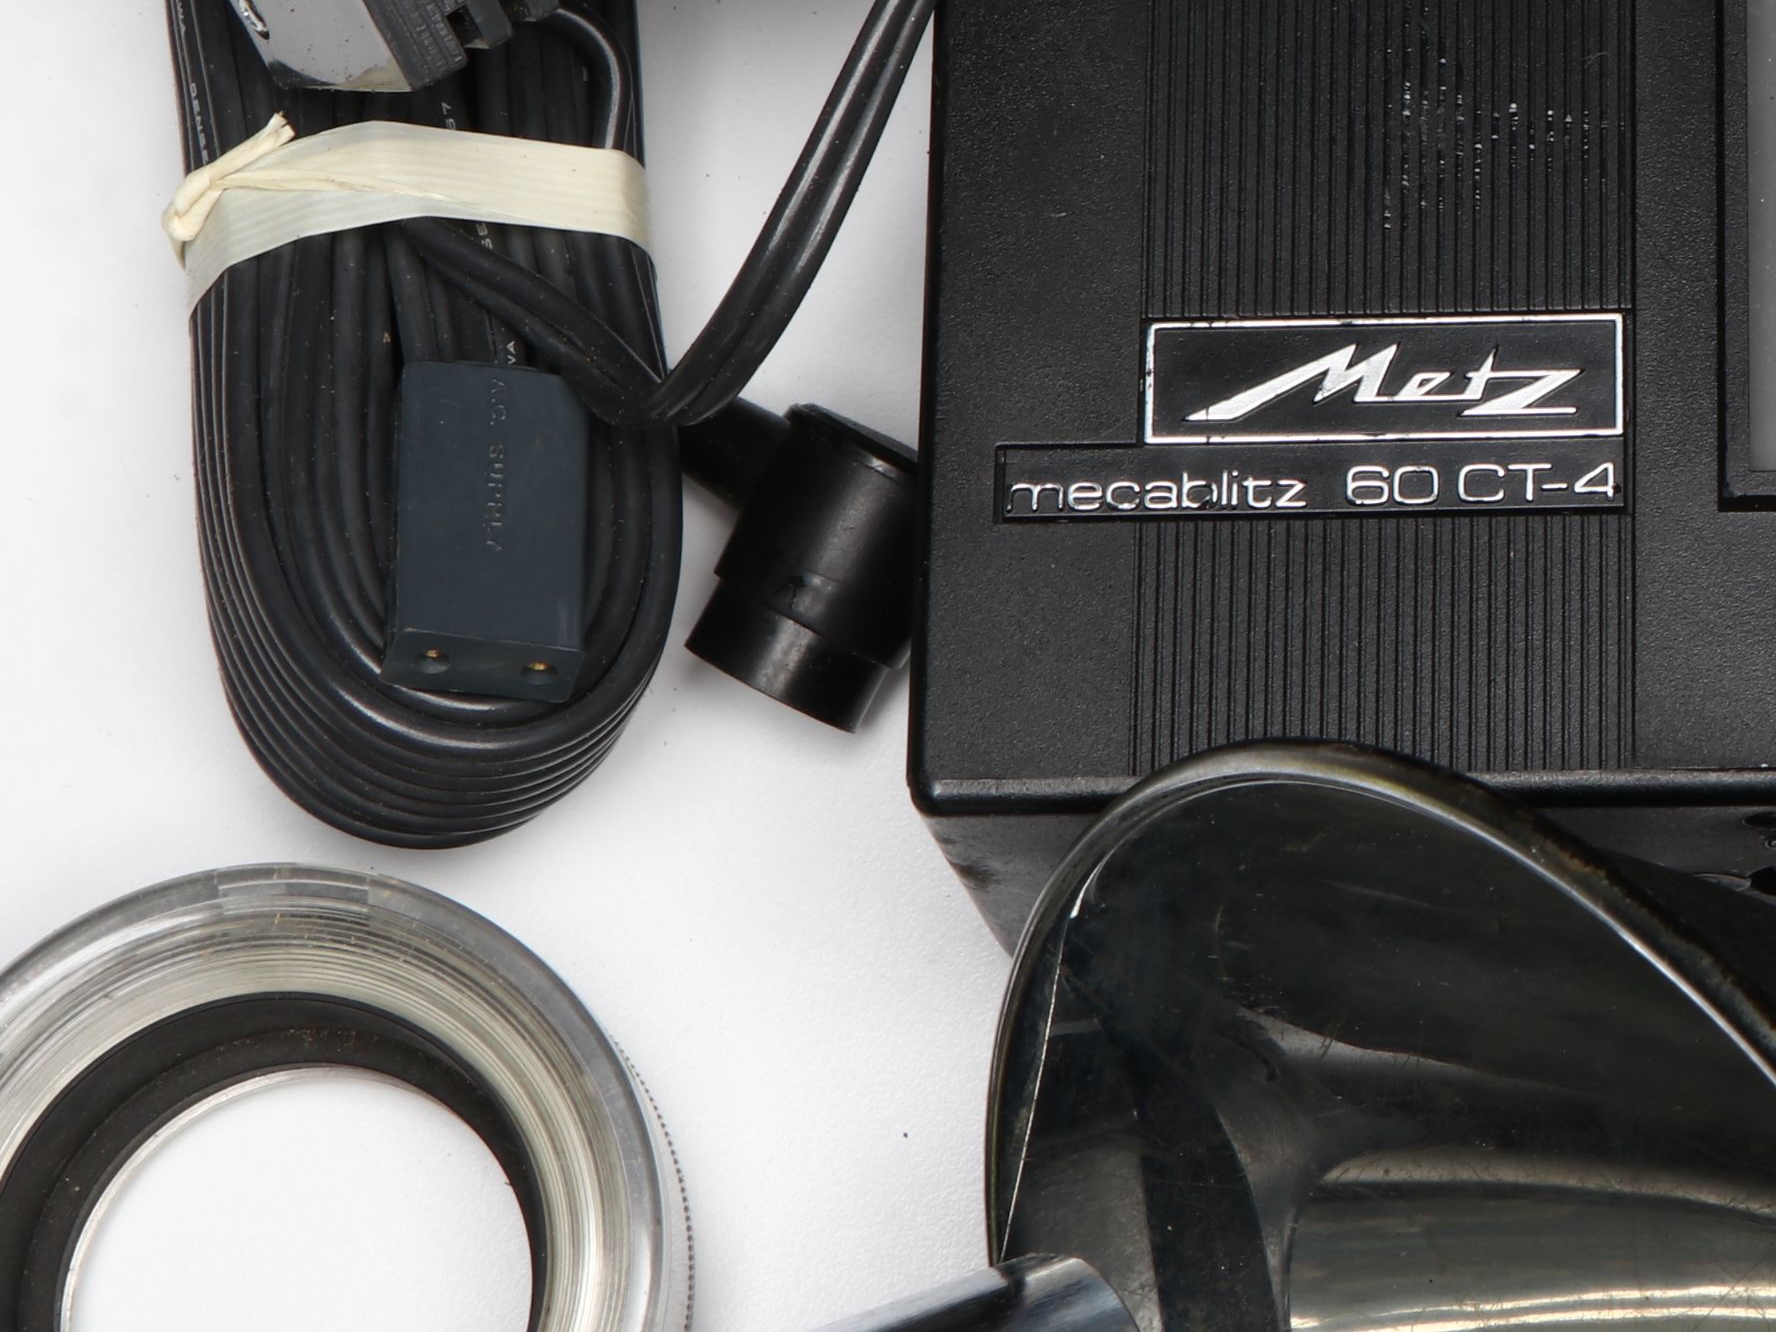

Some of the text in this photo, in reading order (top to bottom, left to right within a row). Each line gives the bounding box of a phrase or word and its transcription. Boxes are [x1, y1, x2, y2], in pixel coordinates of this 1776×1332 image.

[189, 82, 210, 165] DENSE
[1183, 342, 1586, 423] Metz
[485, 378, 506, 554] A.C. SUPPLY
[1007, 462, 1618, 514] mecablitz 60 CT-4
